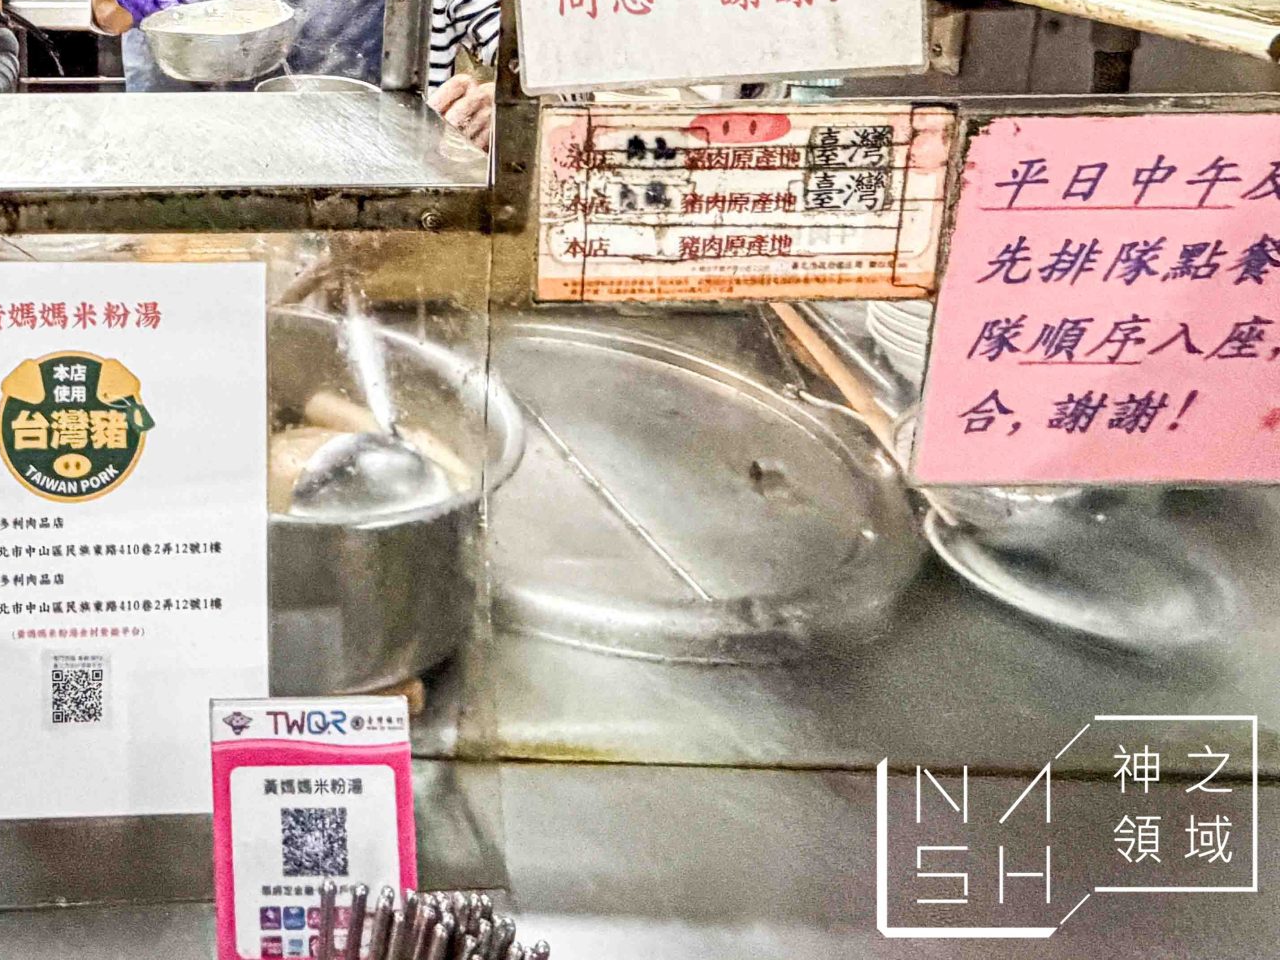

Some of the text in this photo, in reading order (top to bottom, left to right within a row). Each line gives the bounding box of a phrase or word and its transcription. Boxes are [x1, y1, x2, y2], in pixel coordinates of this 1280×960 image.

[814, 127, 893, 167] 臺灣
[680, 191, 797, 215] 豬肉原產地
[805, 172, 887, 212] 臺灣
[564, 233, 793, 258] 本店 豬肉原產地
[976, 233, 1280, 286] 先排隊點餐
[53, 363, 87, 383] 本店
[53, 384, 86, 403] 使用
[11, 409, 129, 451] 台灣豬
[23, 464, 120, 494] TAIWAN PORK
[265, 711, 347, 735] TWQR
